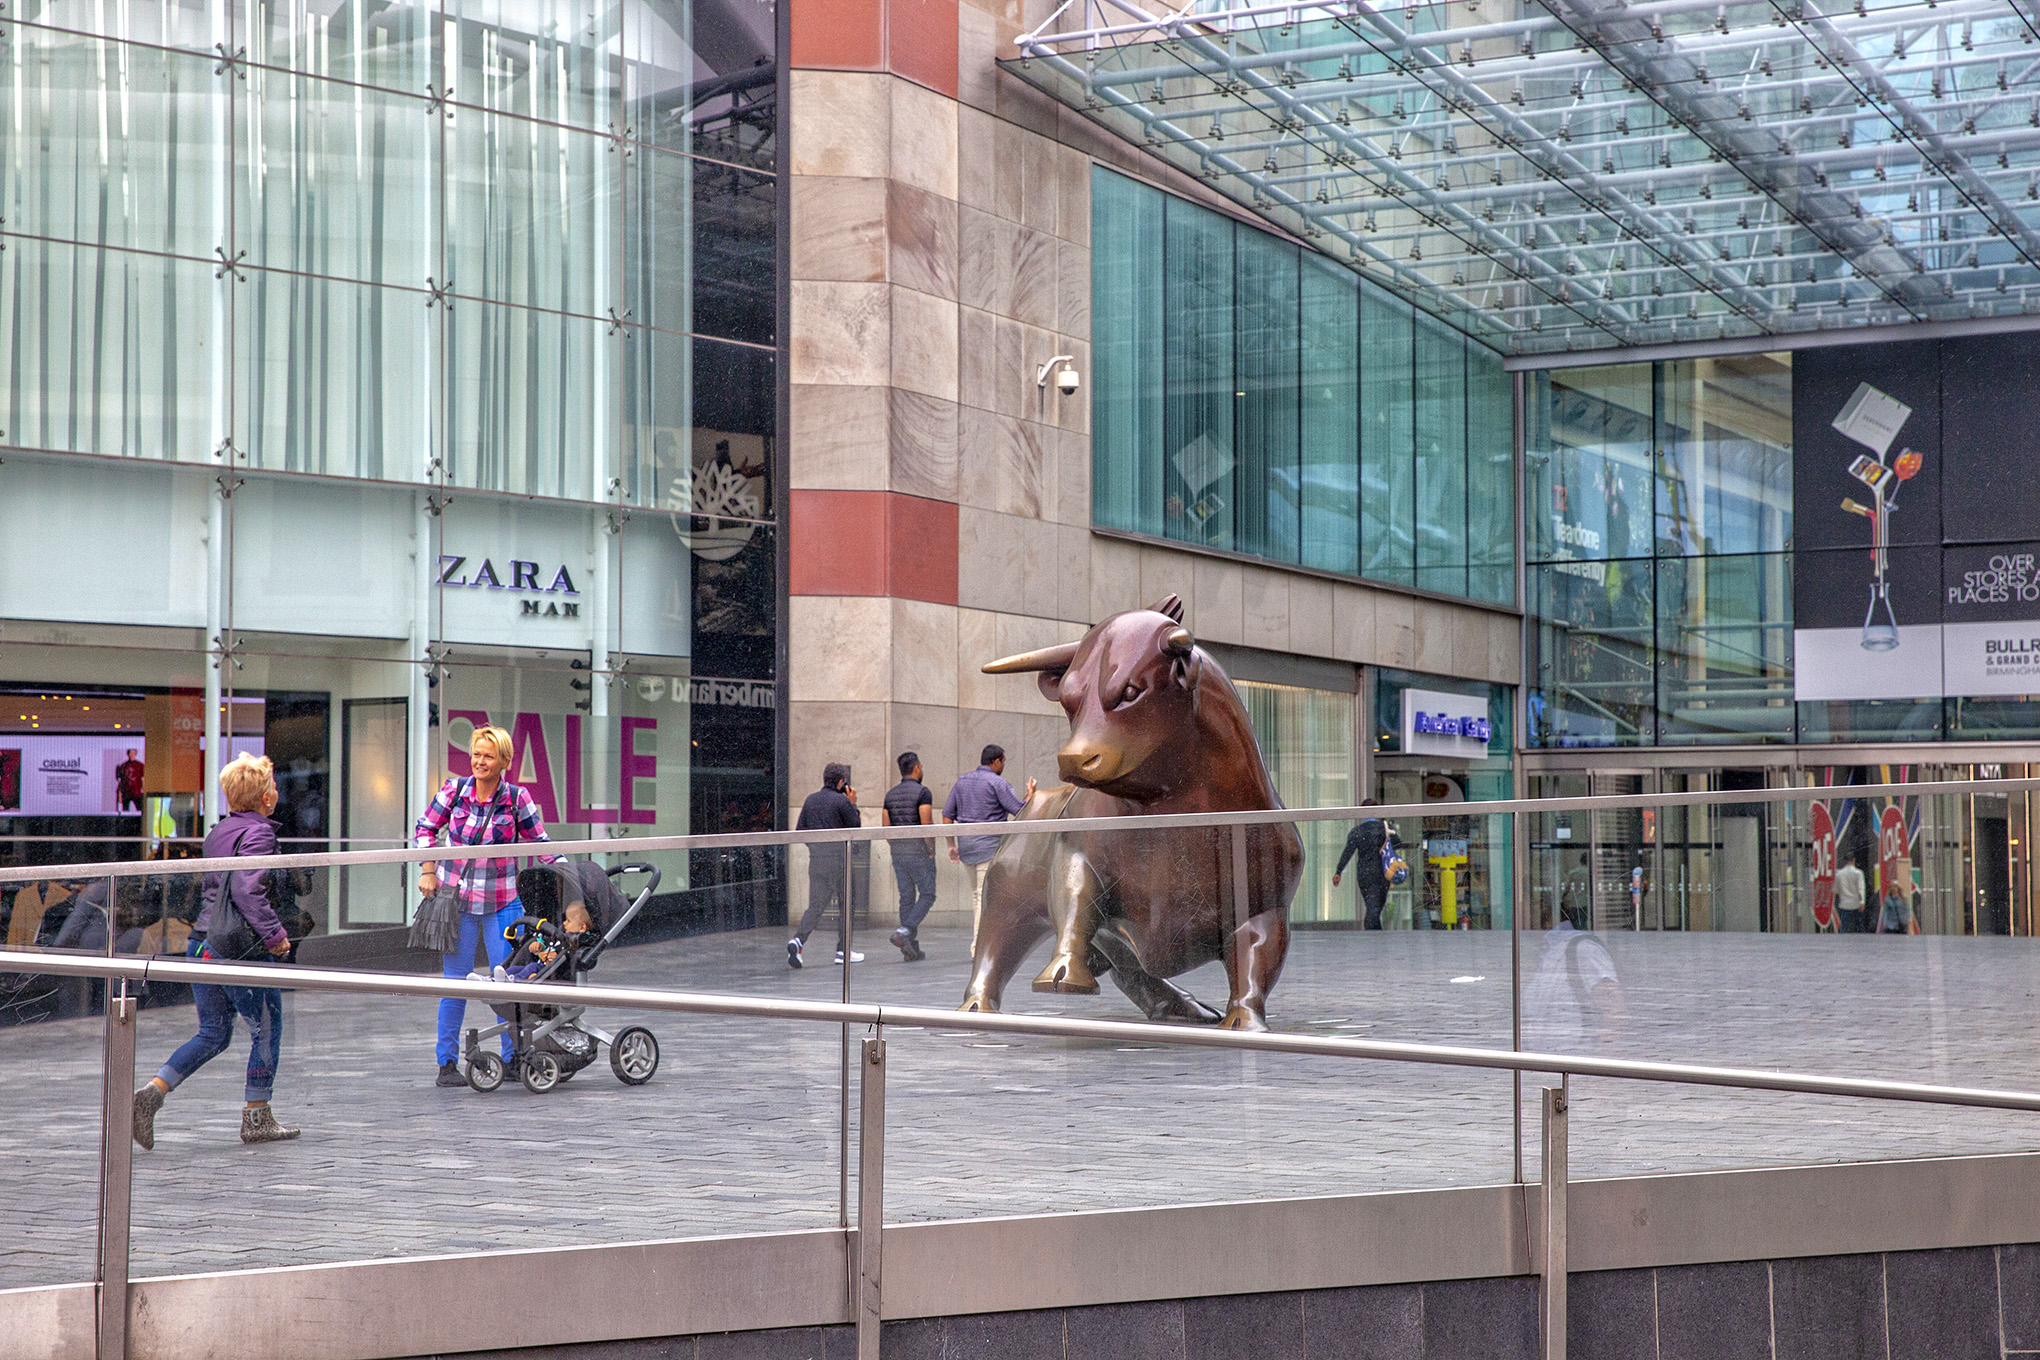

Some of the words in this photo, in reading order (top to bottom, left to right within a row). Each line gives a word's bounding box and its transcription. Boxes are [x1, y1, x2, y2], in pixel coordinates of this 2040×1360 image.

[1552, 515, 1573, 543] Tea
[1574, 521, 1599, 550] done
[1989, 554, 2035, 572] OVER
[436, 555, 580, 595] ZARA
[1963, 569, 2028, 590] STORES
[1948, 585, 2010, 604] PLACES
[2015, 584, 2040, 602] TO
[520, 600, 580, 618] MAN
[1985, 639, 2040, 654] BULLR
[1996, 655, 2030, 666] GRAND
[42, 756, 81, 769] casual
